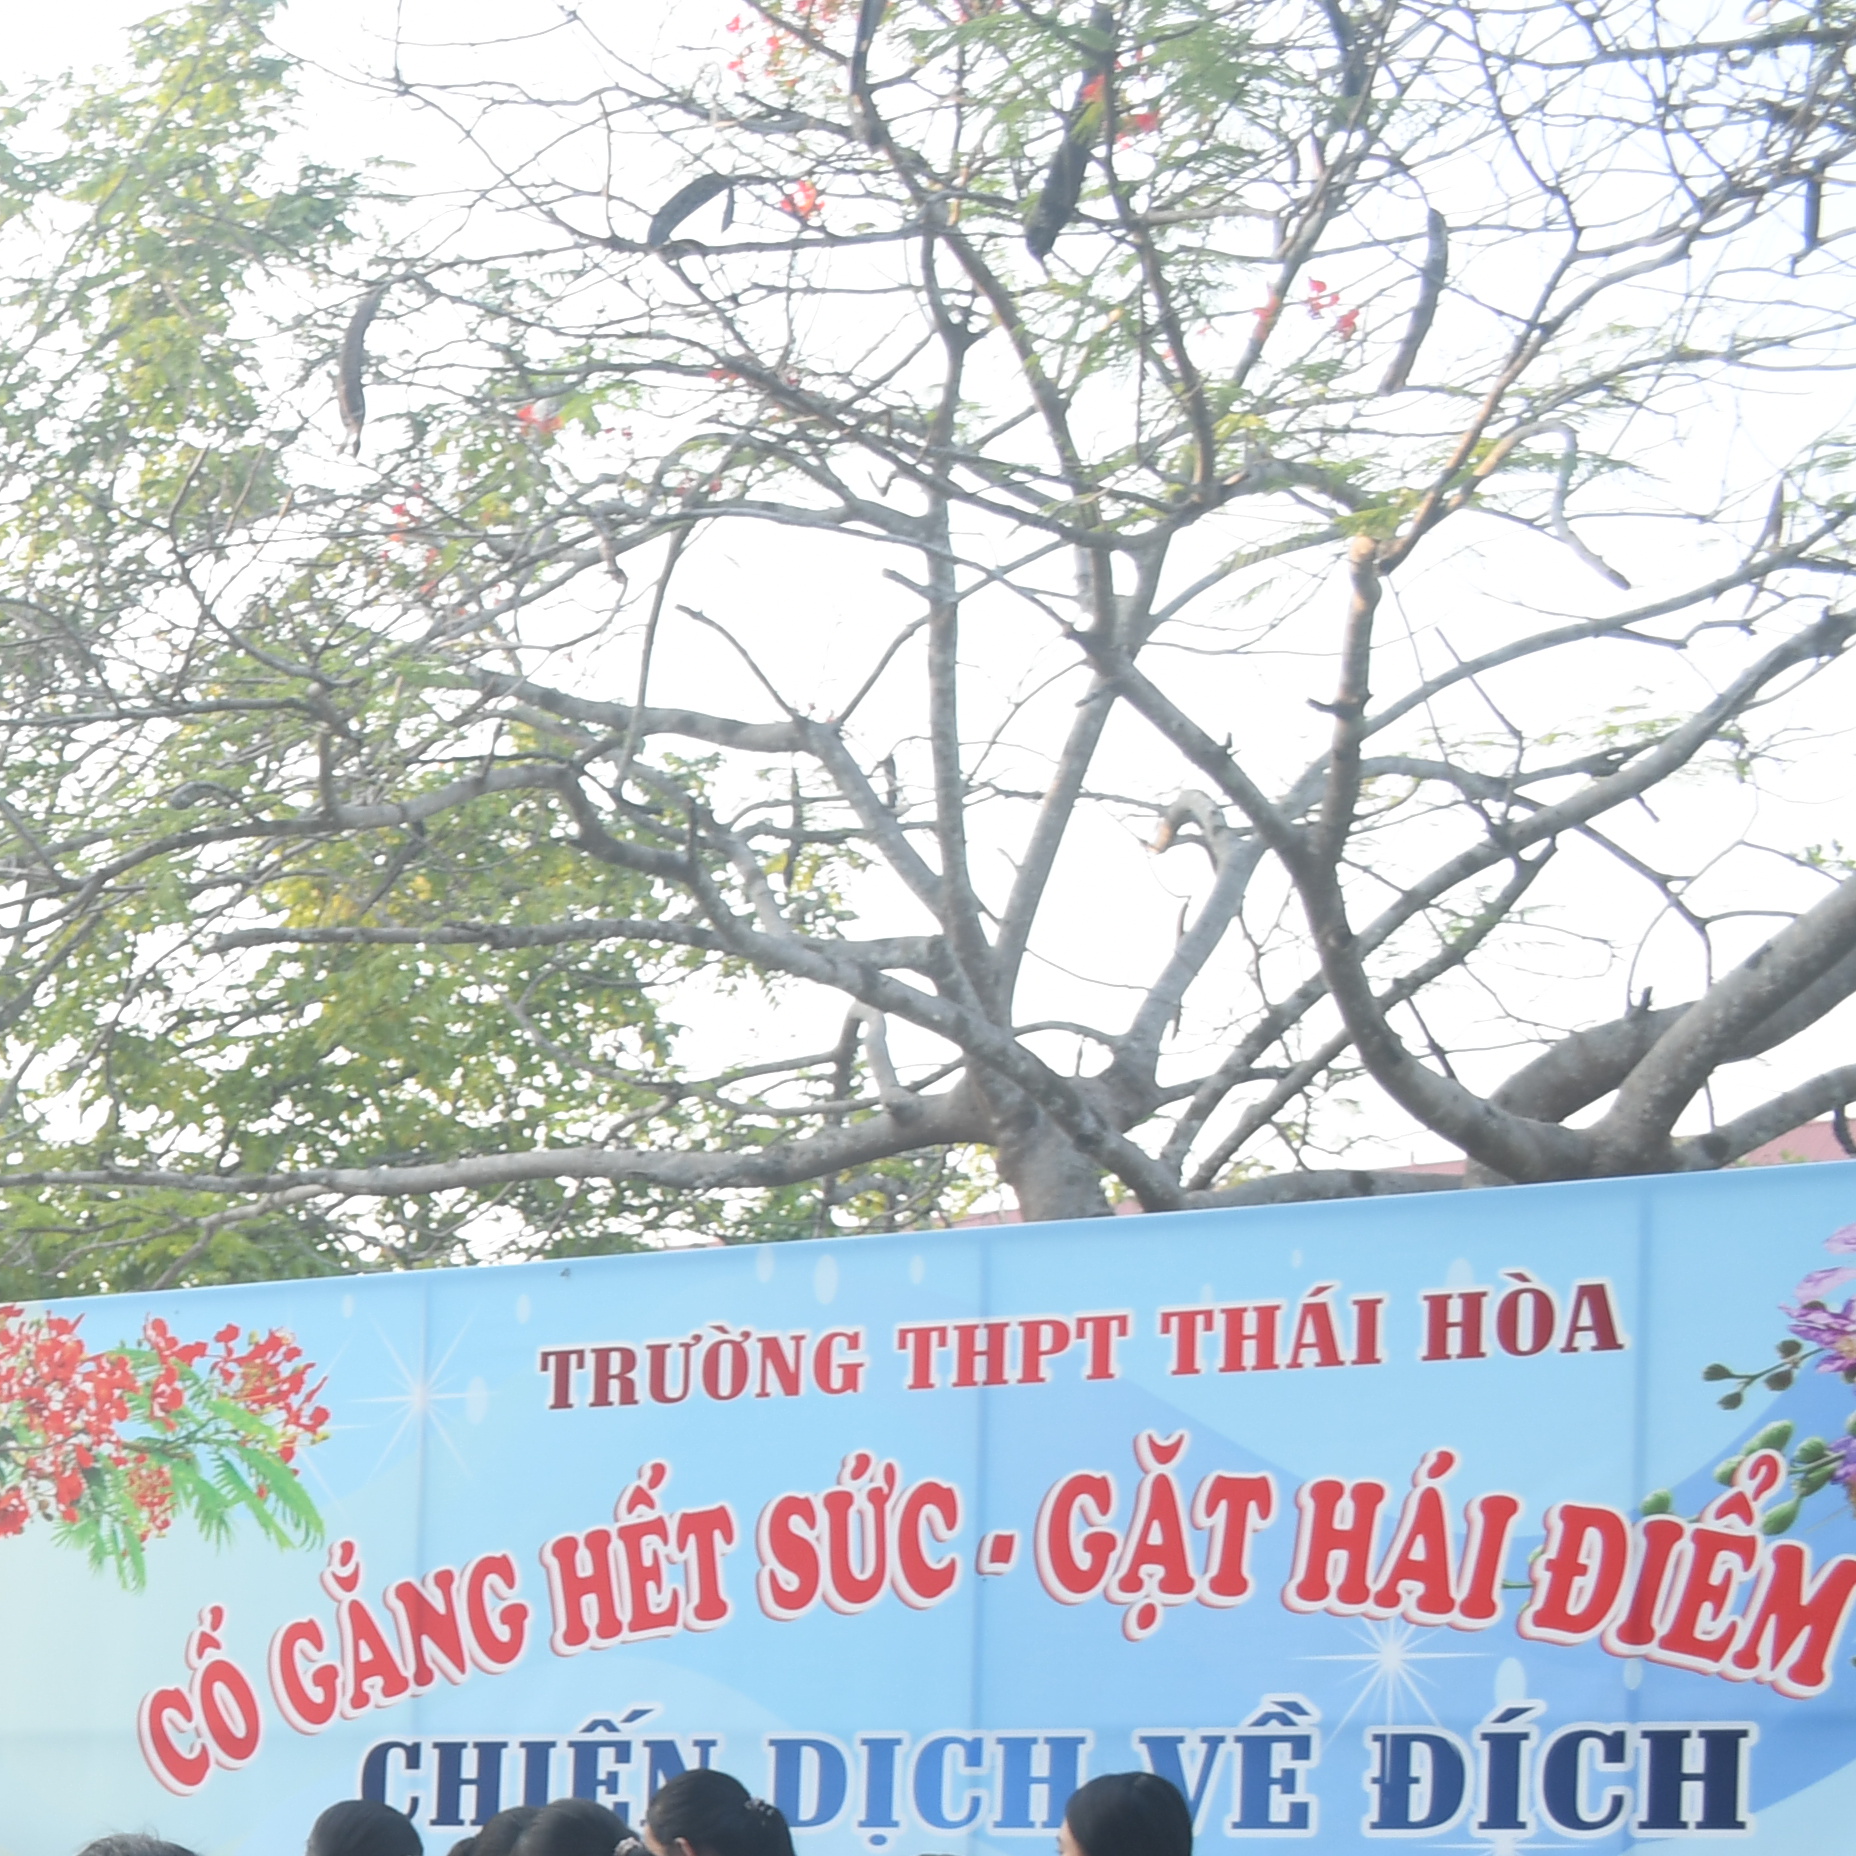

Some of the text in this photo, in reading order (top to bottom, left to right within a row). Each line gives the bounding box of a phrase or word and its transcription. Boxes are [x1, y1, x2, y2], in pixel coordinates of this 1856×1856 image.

[540, 1272, 1624, 1410] TRƯỜNG THPT THÁI HÒA
[141, 1603, 261, 1793] CỐ
[270, 1540, 528, 1732] GẮNG
[542, 1461, 734, 1655] HẾT
[759, 1452, 959, 1619] SỨC
[1037, 1431, 1274, 1640] GẶT
[1284, 1449, 1521, 1630] HÁI
[1519, 1452, 1856, 1698] ĐIỂM
[767, 1736, 1086, 1845] DỊCH
[1139, 1700, 1312, 1830] VỀ
[1369, 1707, 1750, 1831] ĐÍCH
